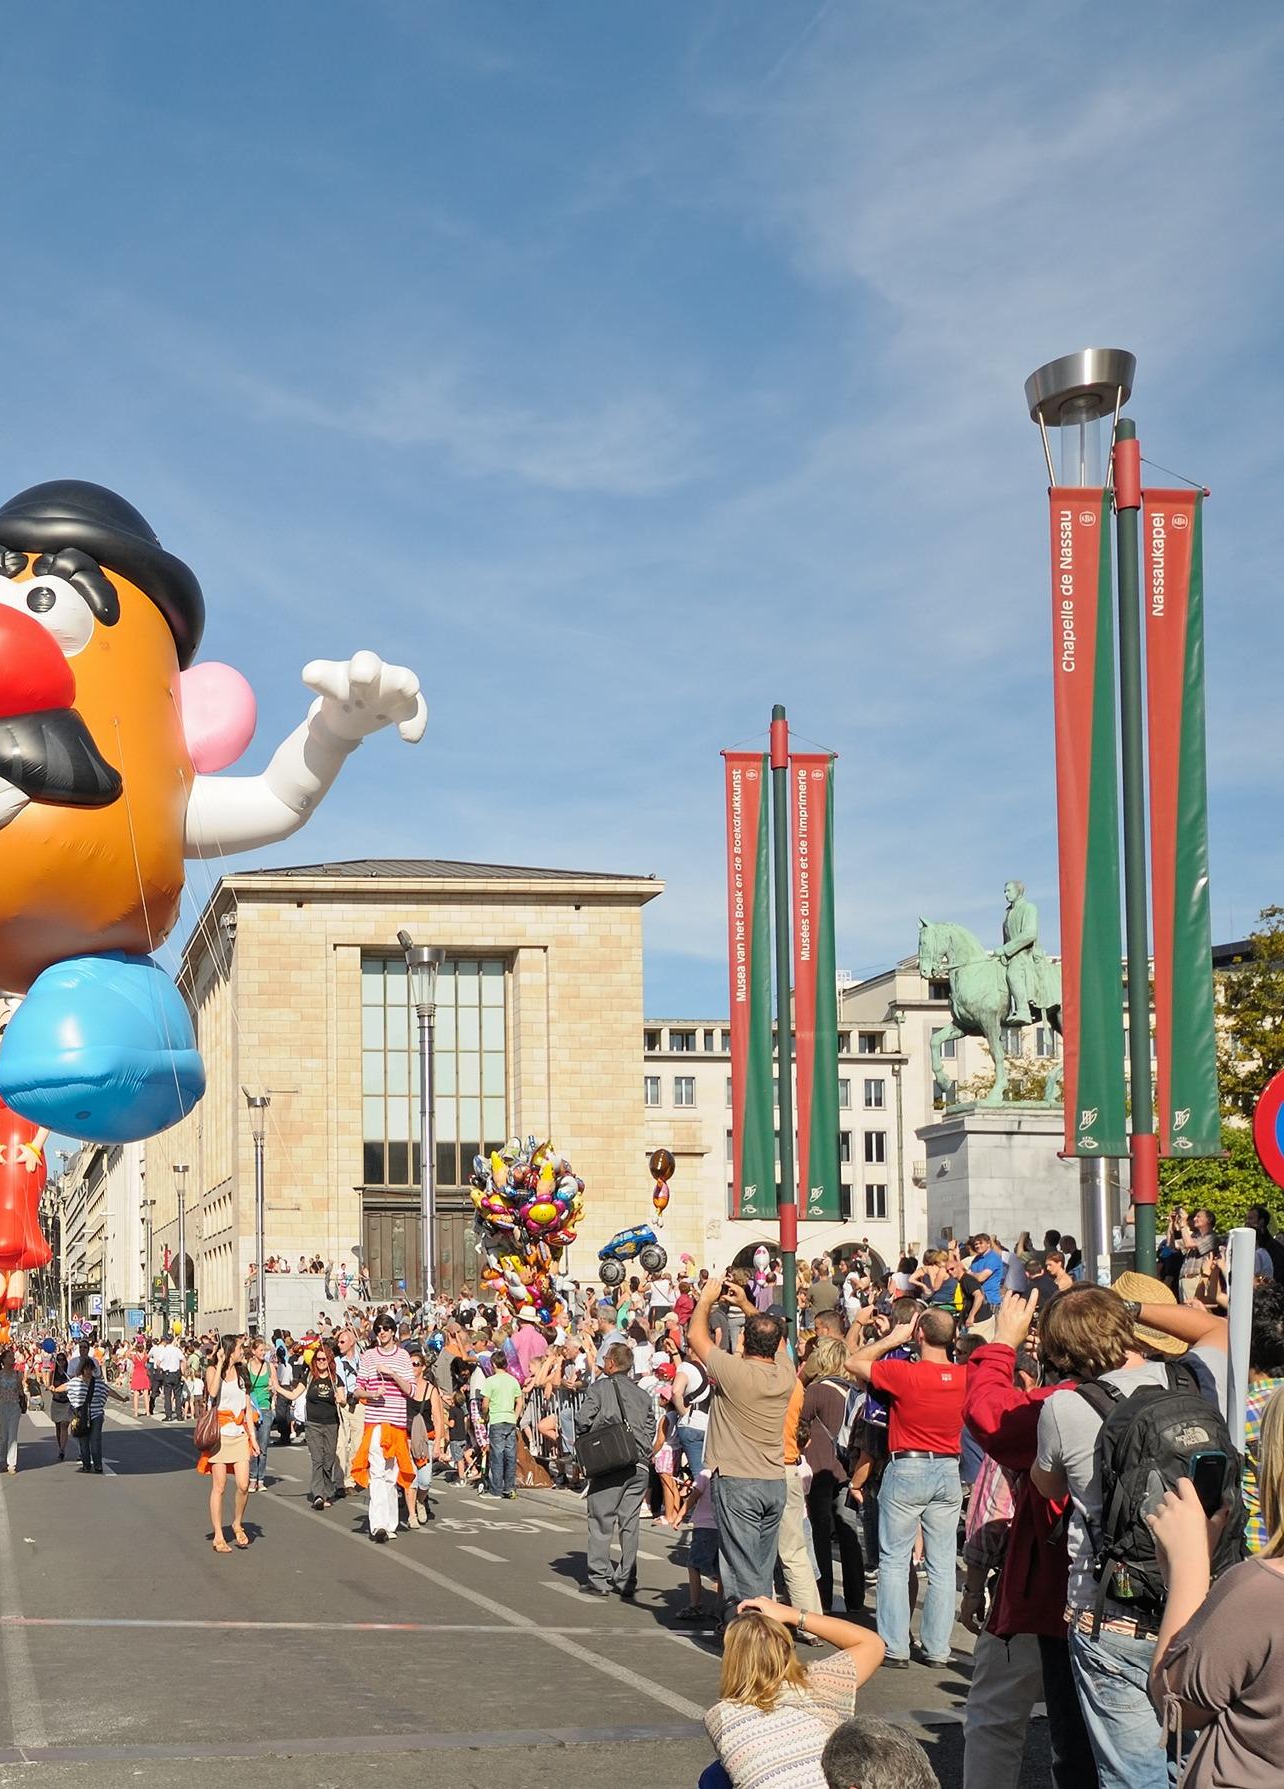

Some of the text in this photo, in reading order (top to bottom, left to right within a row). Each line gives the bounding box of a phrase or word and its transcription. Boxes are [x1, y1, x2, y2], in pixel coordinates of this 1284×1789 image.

[1150, 512, 1167, 617] Nassaukapel
[1059, 510, 1076, 673] Chapelle de Nassau
[798, 839, 808, 855] de
[799, 856, 809, 870] et
[731, 768, 746, 1002] Musea van het Boek en de Boekdrukkunst
[799, 871, 809, 899] Livre
[799, 901, 810, 917] du
[799, 918, 810, 961] Musées
